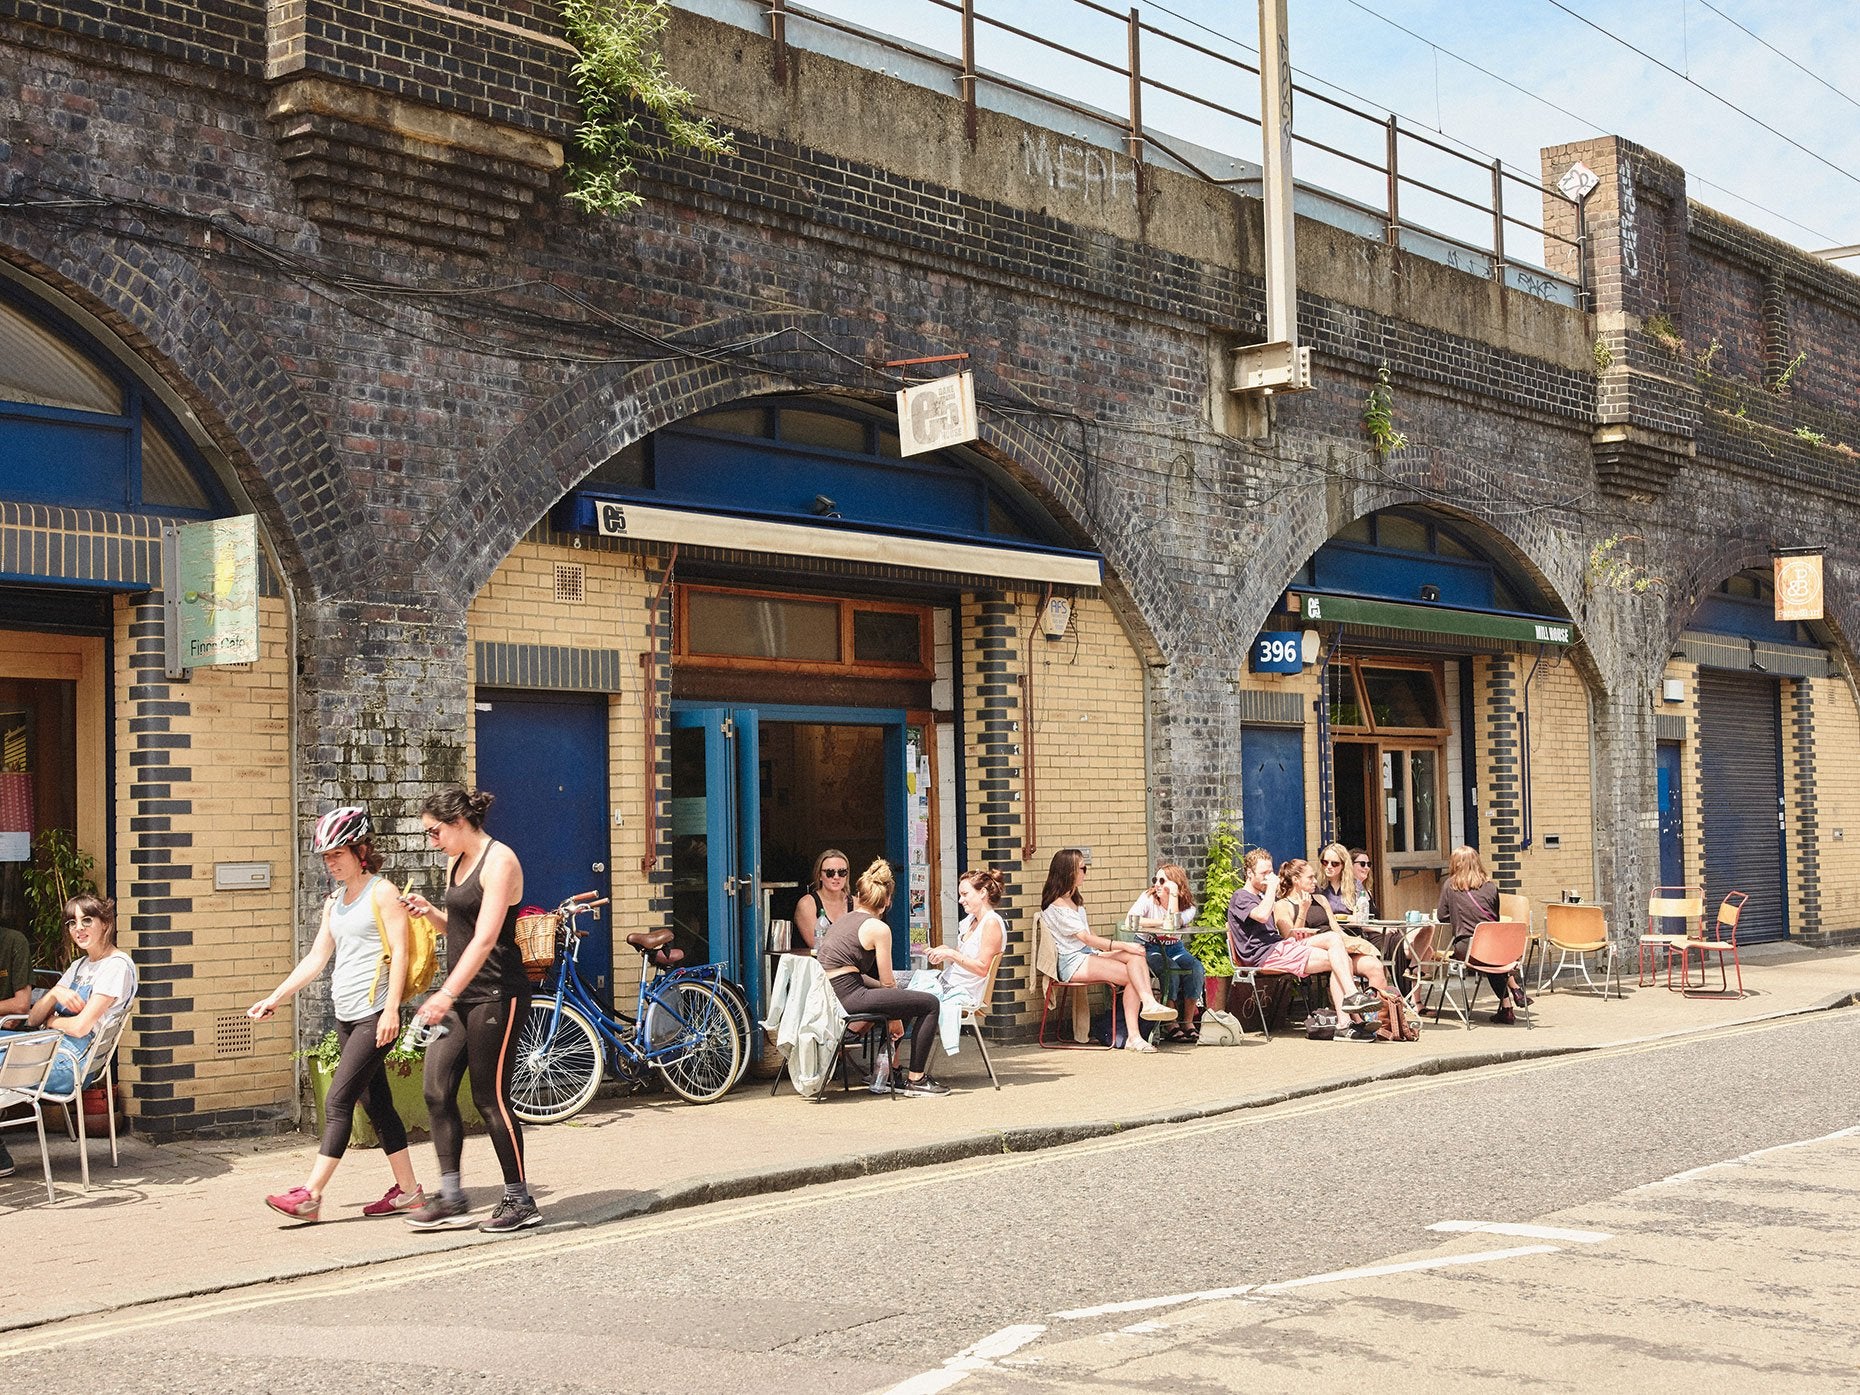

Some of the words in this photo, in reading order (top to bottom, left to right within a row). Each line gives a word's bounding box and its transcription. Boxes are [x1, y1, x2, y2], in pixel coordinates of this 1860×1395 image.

[1051, 600, 1067, 614] AFS
[1549, 627, 1569, 642] HOUSE
[1260, 640, 1297, 662] 396
